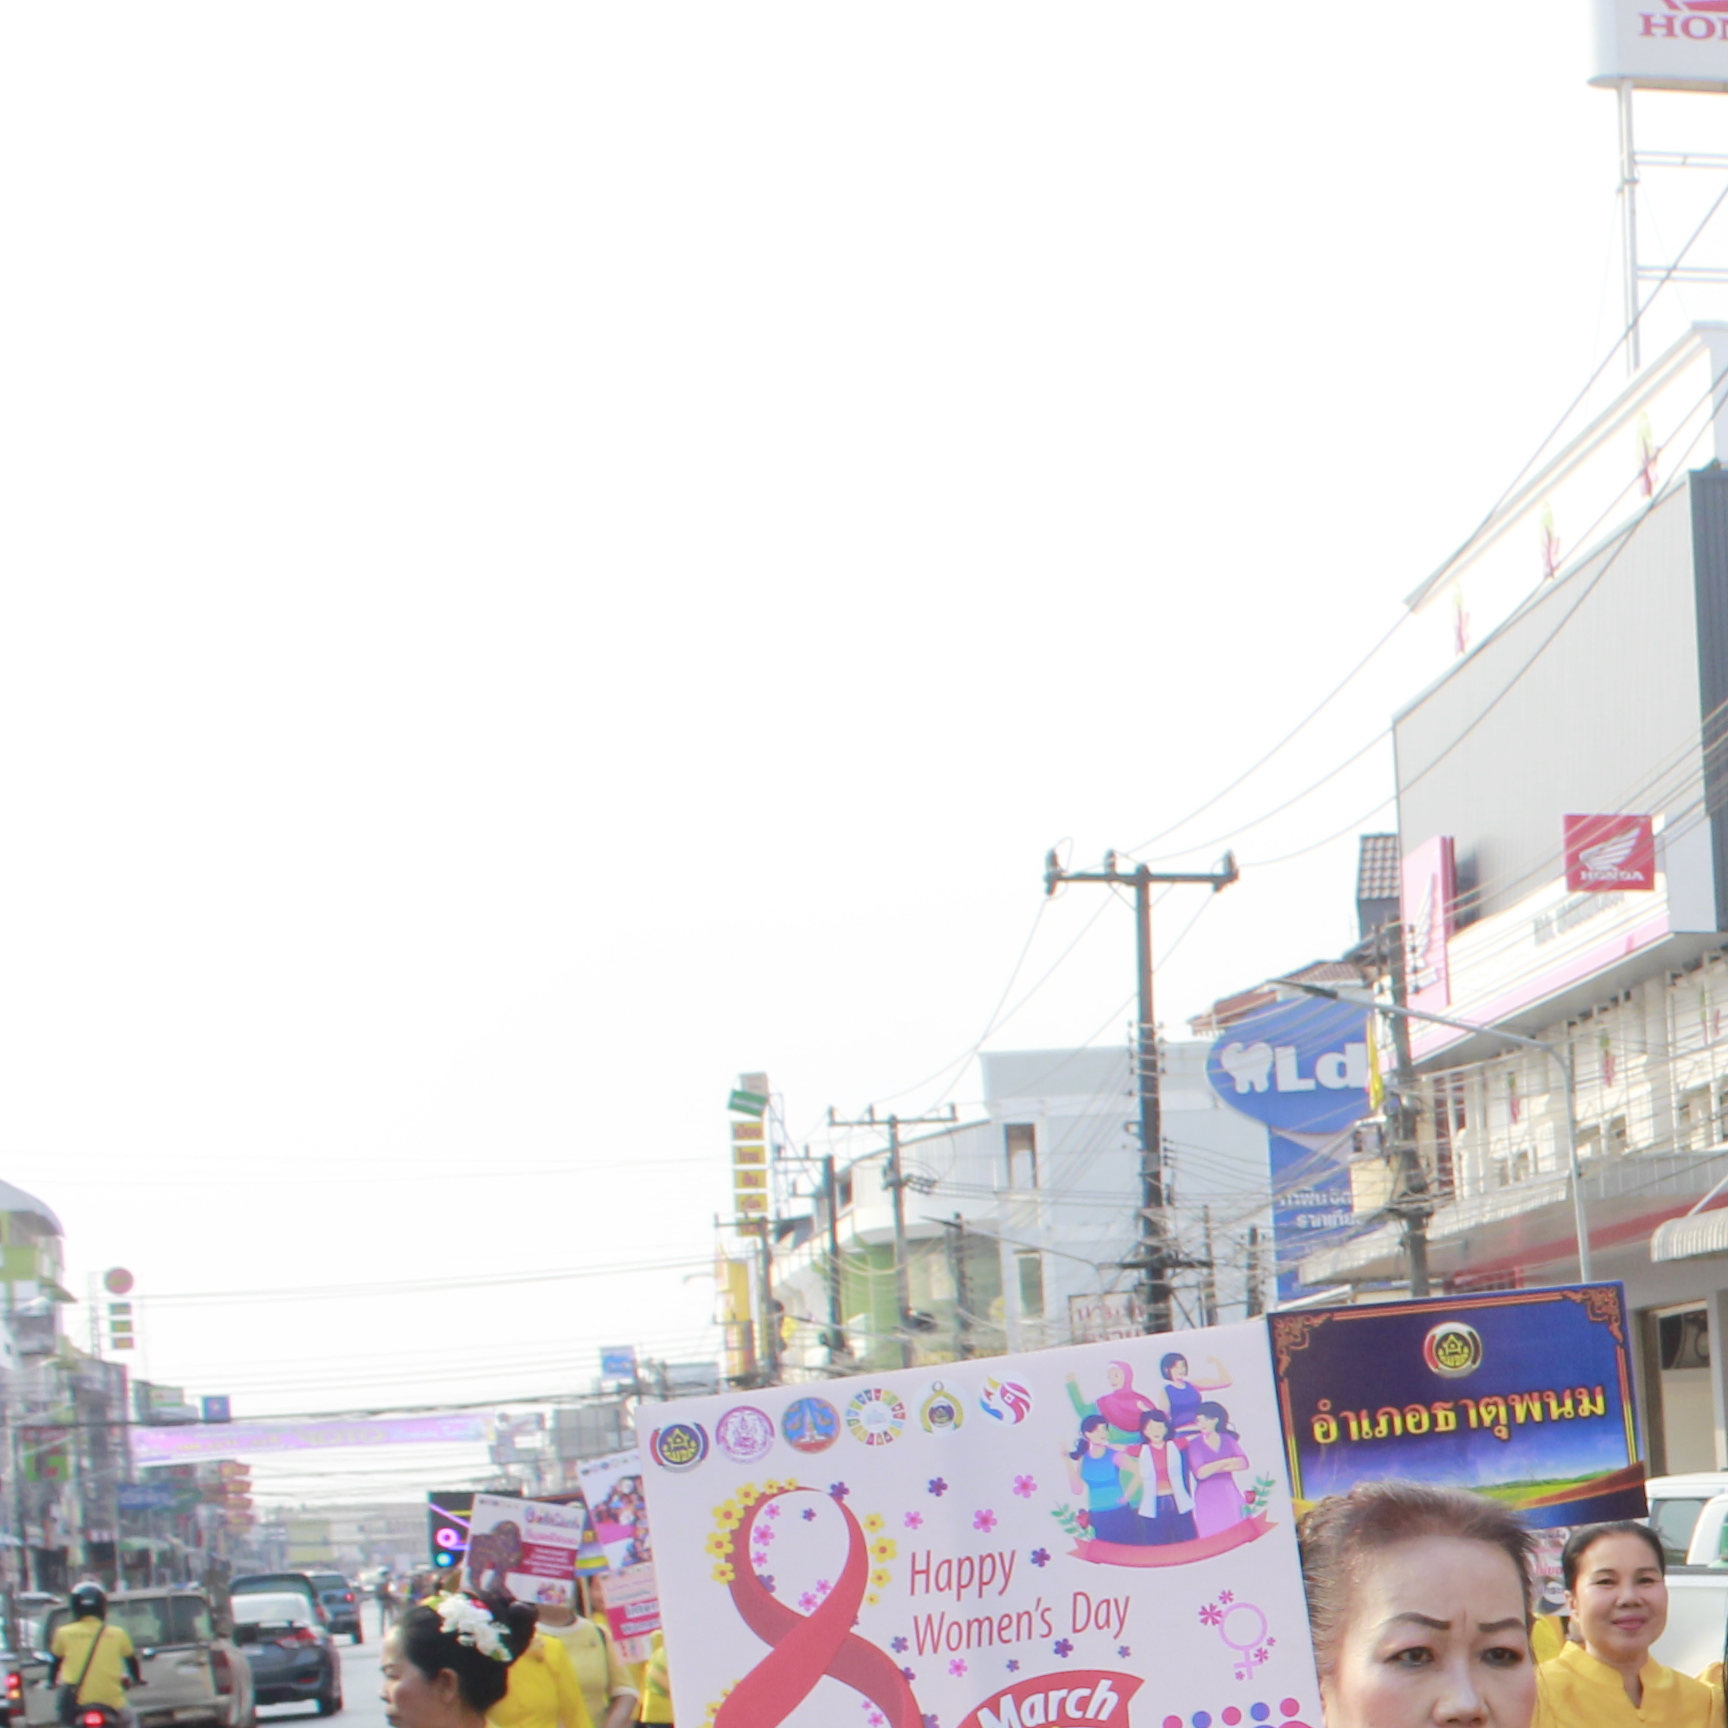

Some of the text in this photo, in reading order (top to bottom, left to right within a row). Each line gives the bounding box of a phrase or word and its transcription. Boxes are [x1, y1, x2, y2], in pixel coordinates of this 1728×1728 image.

[1579, 868, 1646, 882] HONDA
[1309, 1384, 1607, 1443] อำเภอธาตุพนม
[909, 1548, 1017, 1603] Happy
[1071, 1590, 1132, 1643] Day
